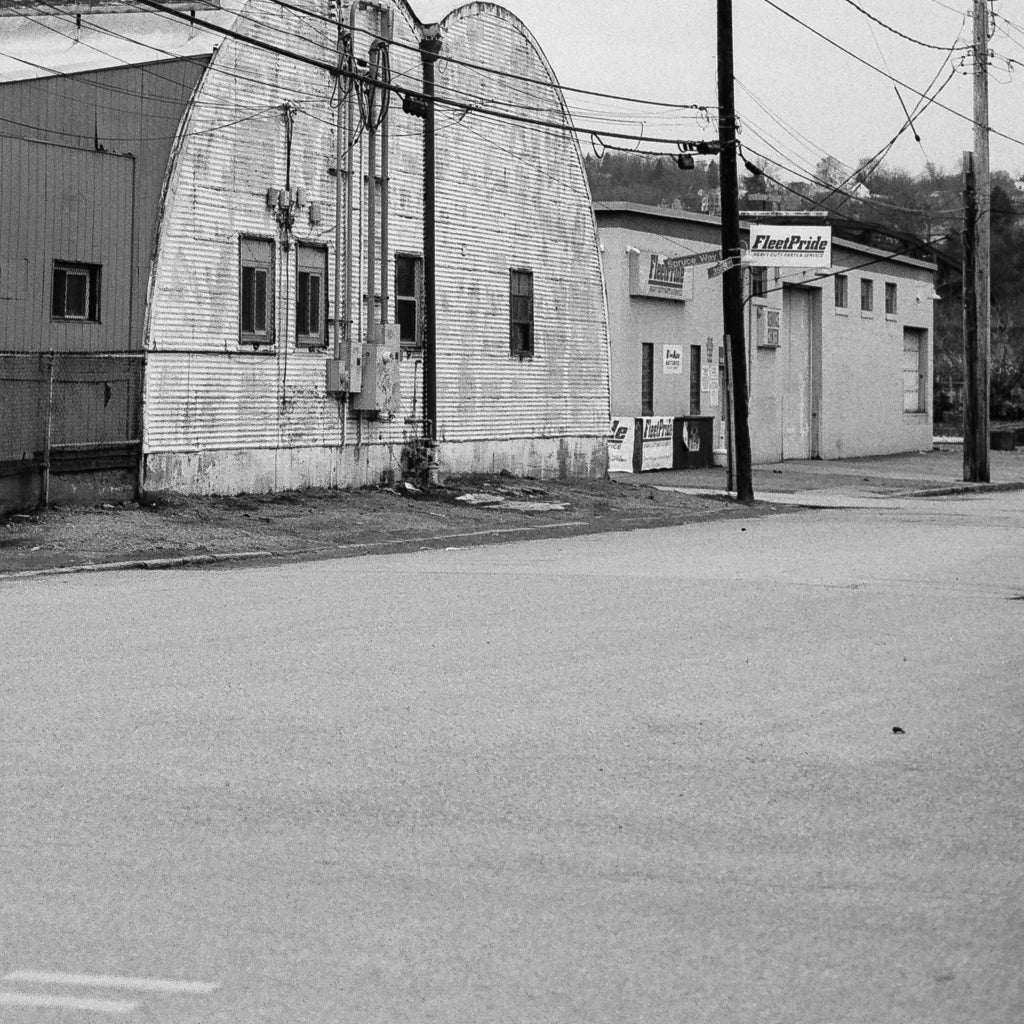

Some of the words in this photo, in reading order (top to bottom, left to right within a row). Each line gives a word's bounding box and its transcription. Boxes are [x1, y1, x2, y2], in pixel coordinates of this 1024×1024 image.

[752, 235, 828, 250] FleetPride
[667, 257, 697, 269] Spruce
[699, 253, 717, 263] Way
